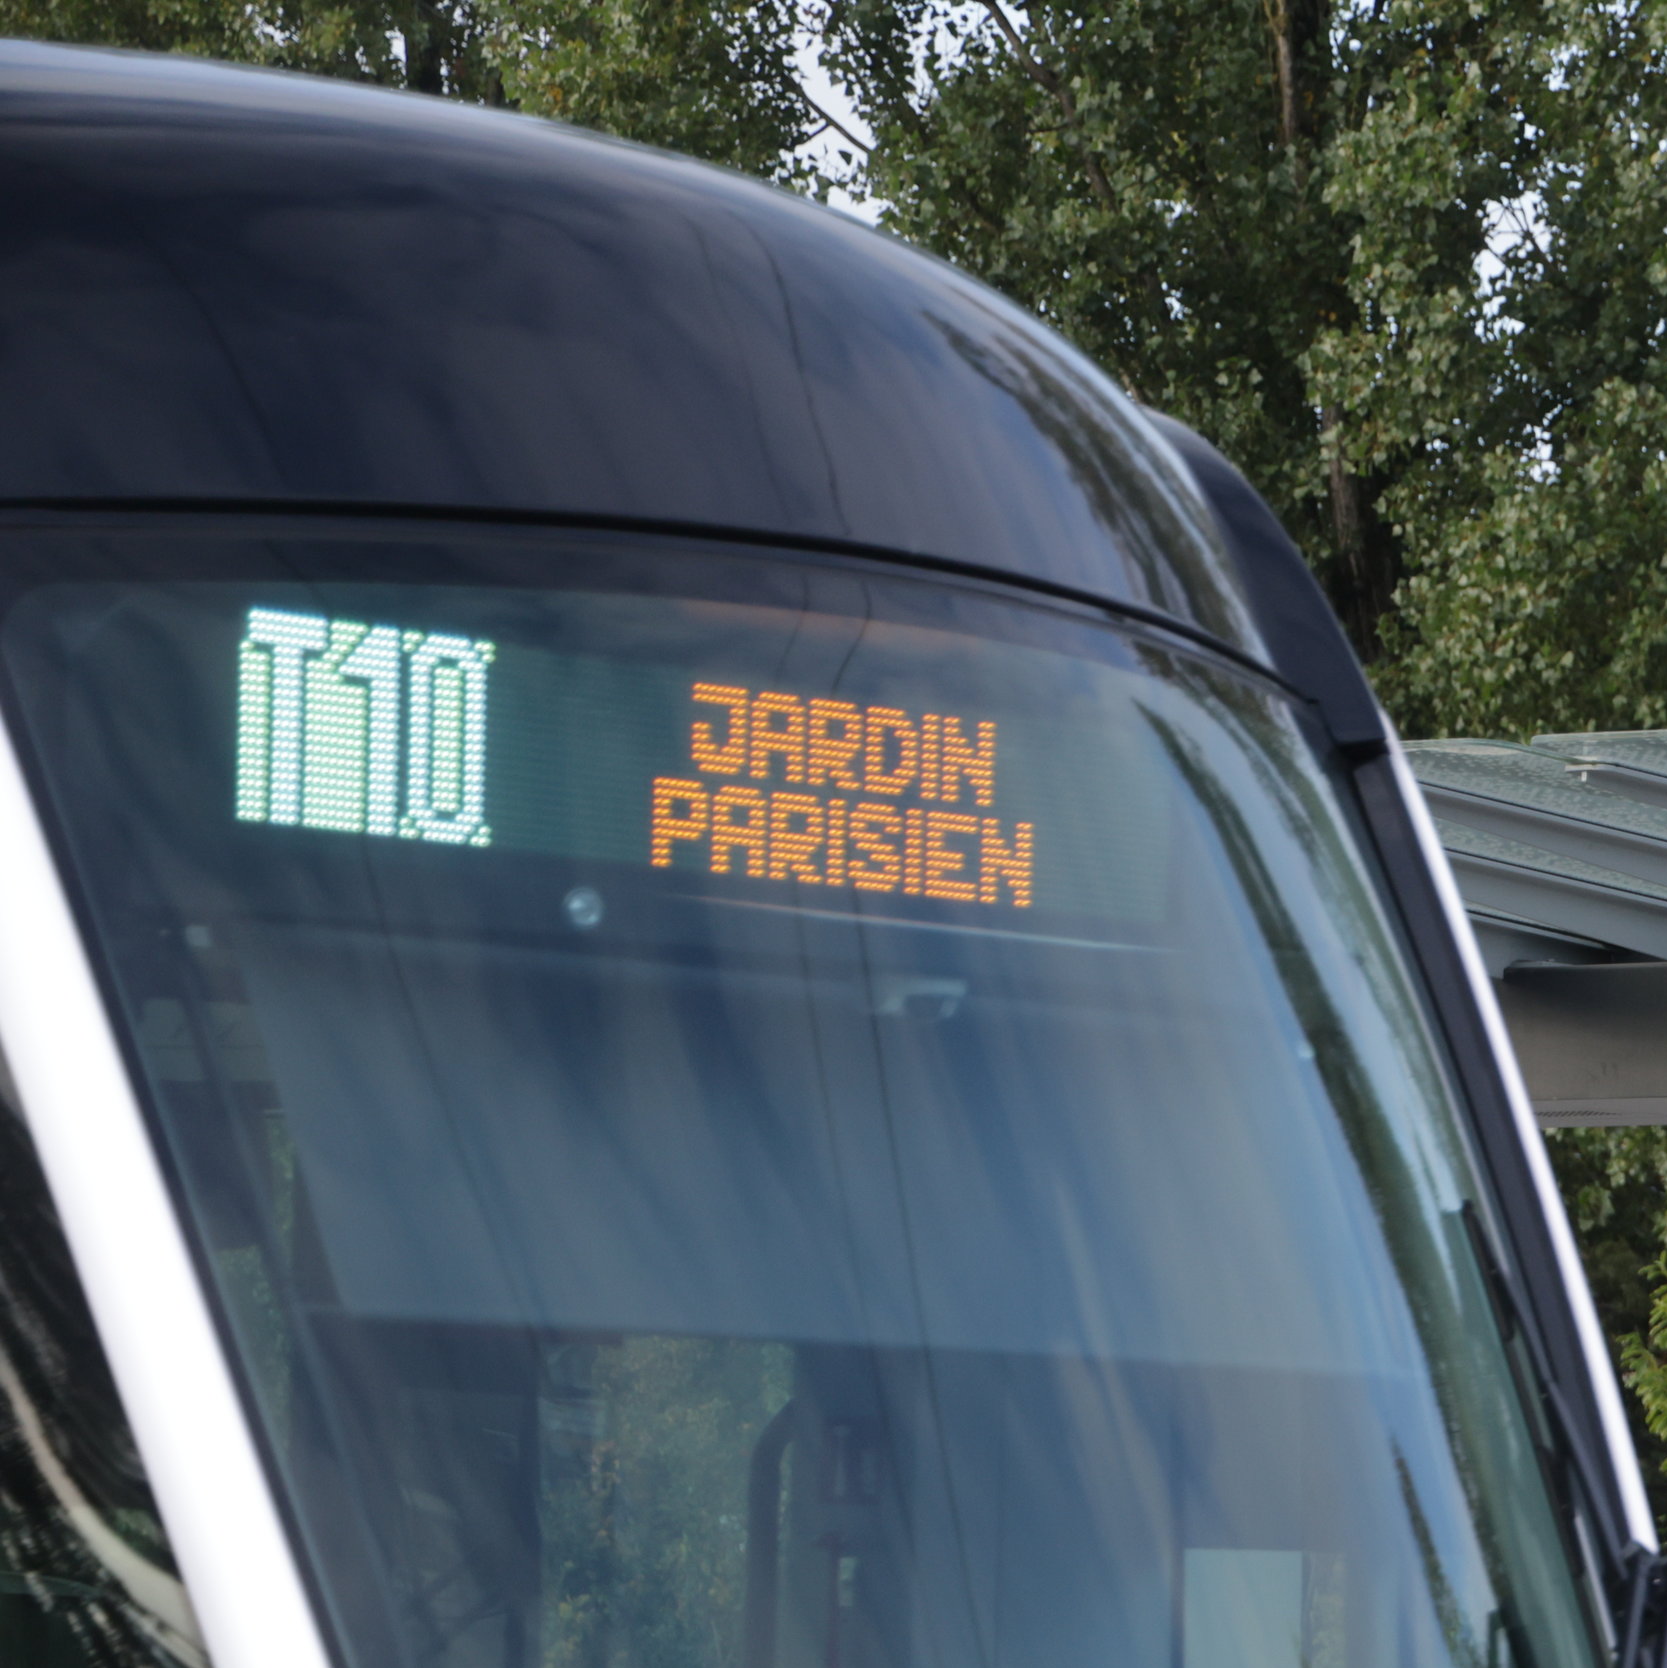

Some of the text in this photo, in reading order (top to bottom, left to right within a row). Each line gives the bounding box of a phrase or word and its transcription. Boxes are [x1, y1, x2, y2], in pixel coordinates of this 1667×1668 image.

[237, 606, 494, 847] T10
[691, 682, 997, 806] JARDIN
[650, 776, 1034, 908] PARISIEN
